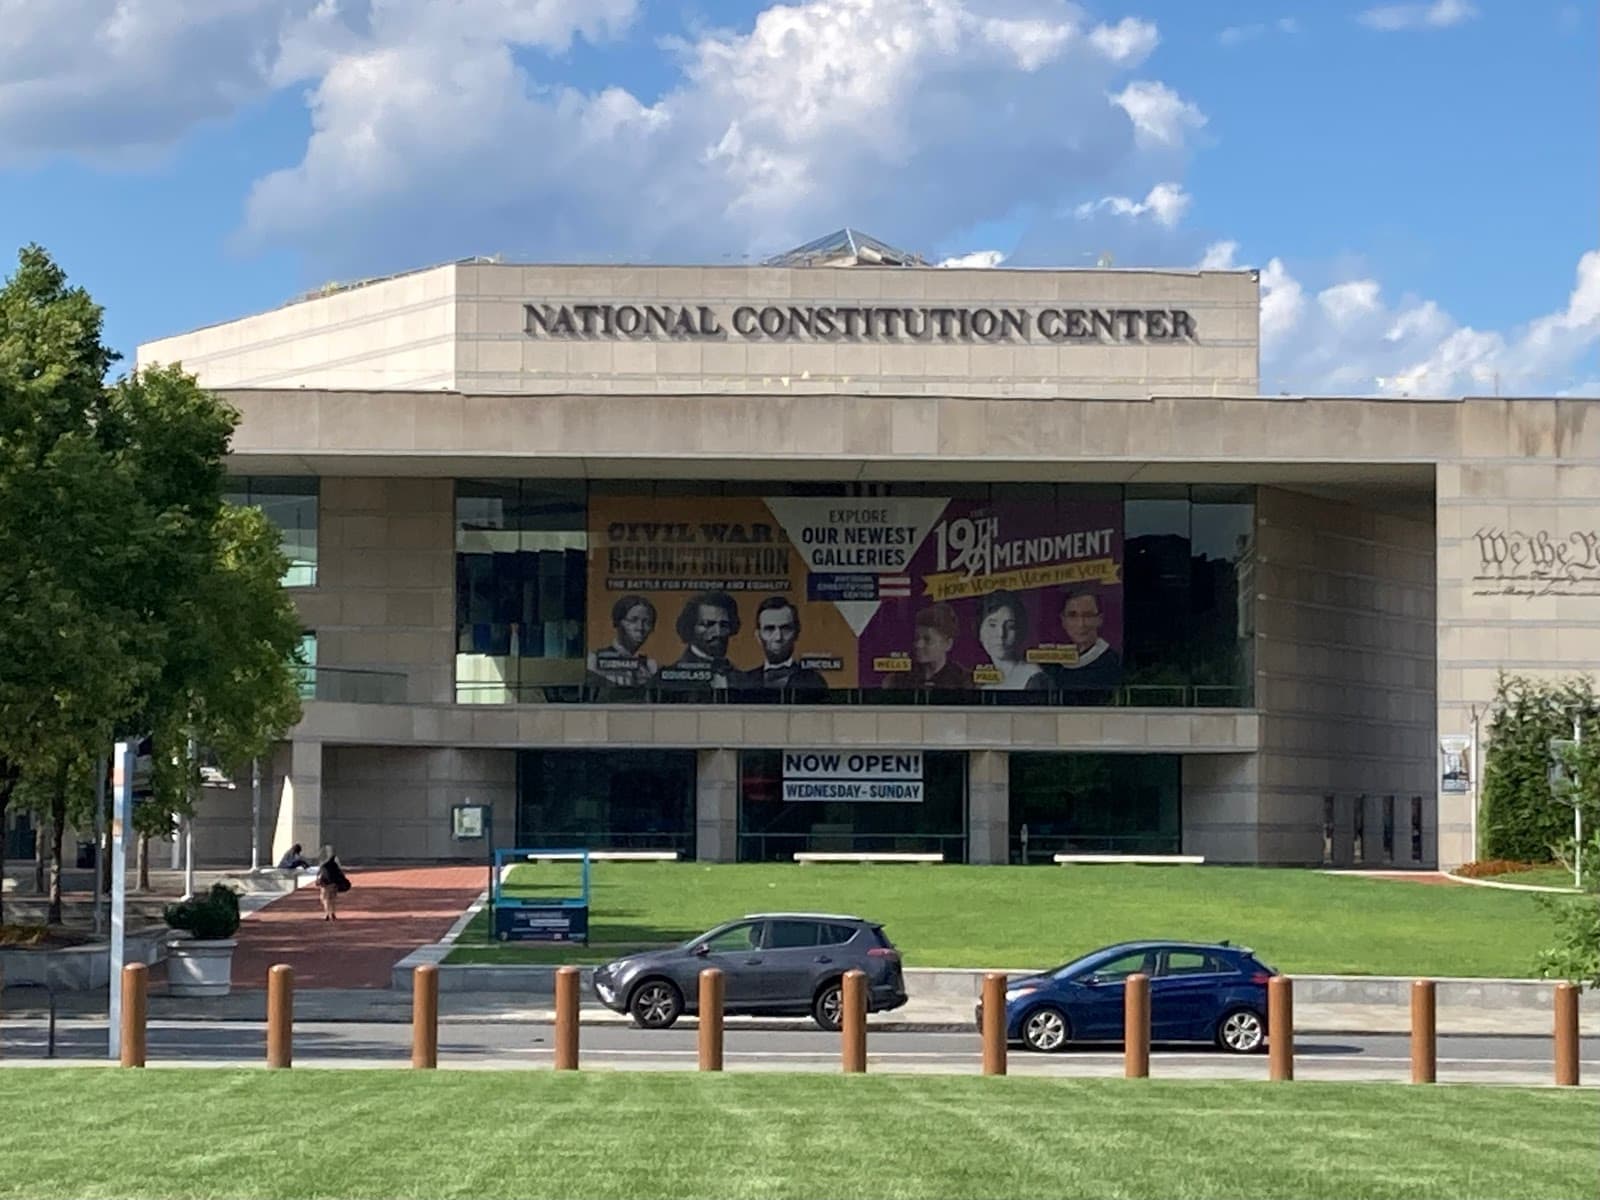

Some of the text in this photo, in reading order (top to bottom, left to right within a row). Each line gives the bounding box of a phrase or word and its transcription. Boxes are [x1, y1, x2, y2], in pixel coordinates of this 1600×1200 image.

[523, 304, 1196, 342] NATIONAL CONSTITUTION CENTER
[829, 509, 889, 524] EXPLORE
[701, 523, 772, 543] WAR
[802, 527, 838, 545] OUR
[844, 527, 917, 545] NEWEST
[812, 548, 905, 566] GALLERIES
[1472, 526, 1528, 574] We
[1527, 530, 1574, 572] the
[785, 754, 920, 773] NOW OPEN!
